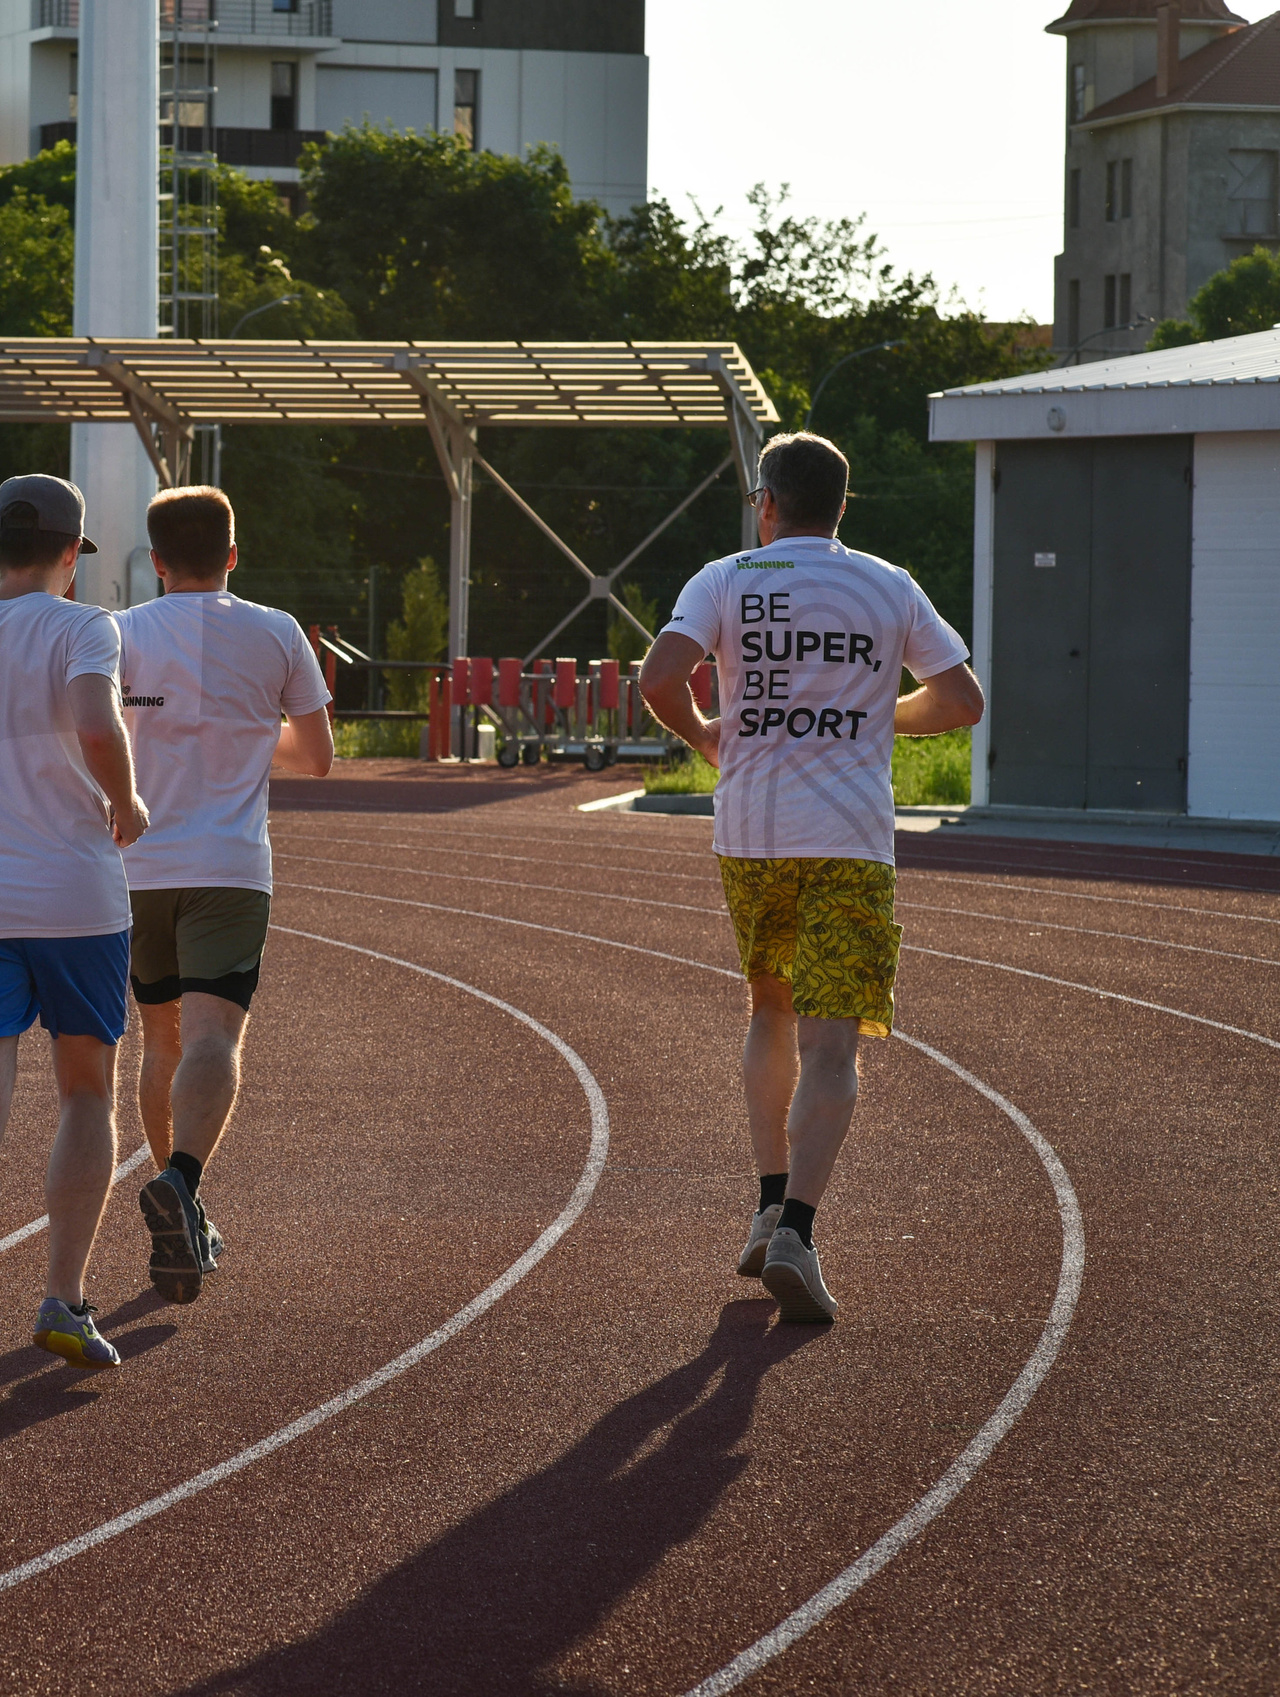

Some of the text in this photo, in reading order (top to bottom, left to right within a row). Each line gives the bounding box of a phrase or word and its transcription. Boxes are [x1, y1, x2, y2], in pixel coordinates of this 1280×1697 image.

[737, 561, 795, 570] RUNNING
[741, 593, 791, 624] BE
[741, 630, 882, 673] SUPER,
[742, 669, 790, 701] BE
[738, 707, 868, 741] SPORT
